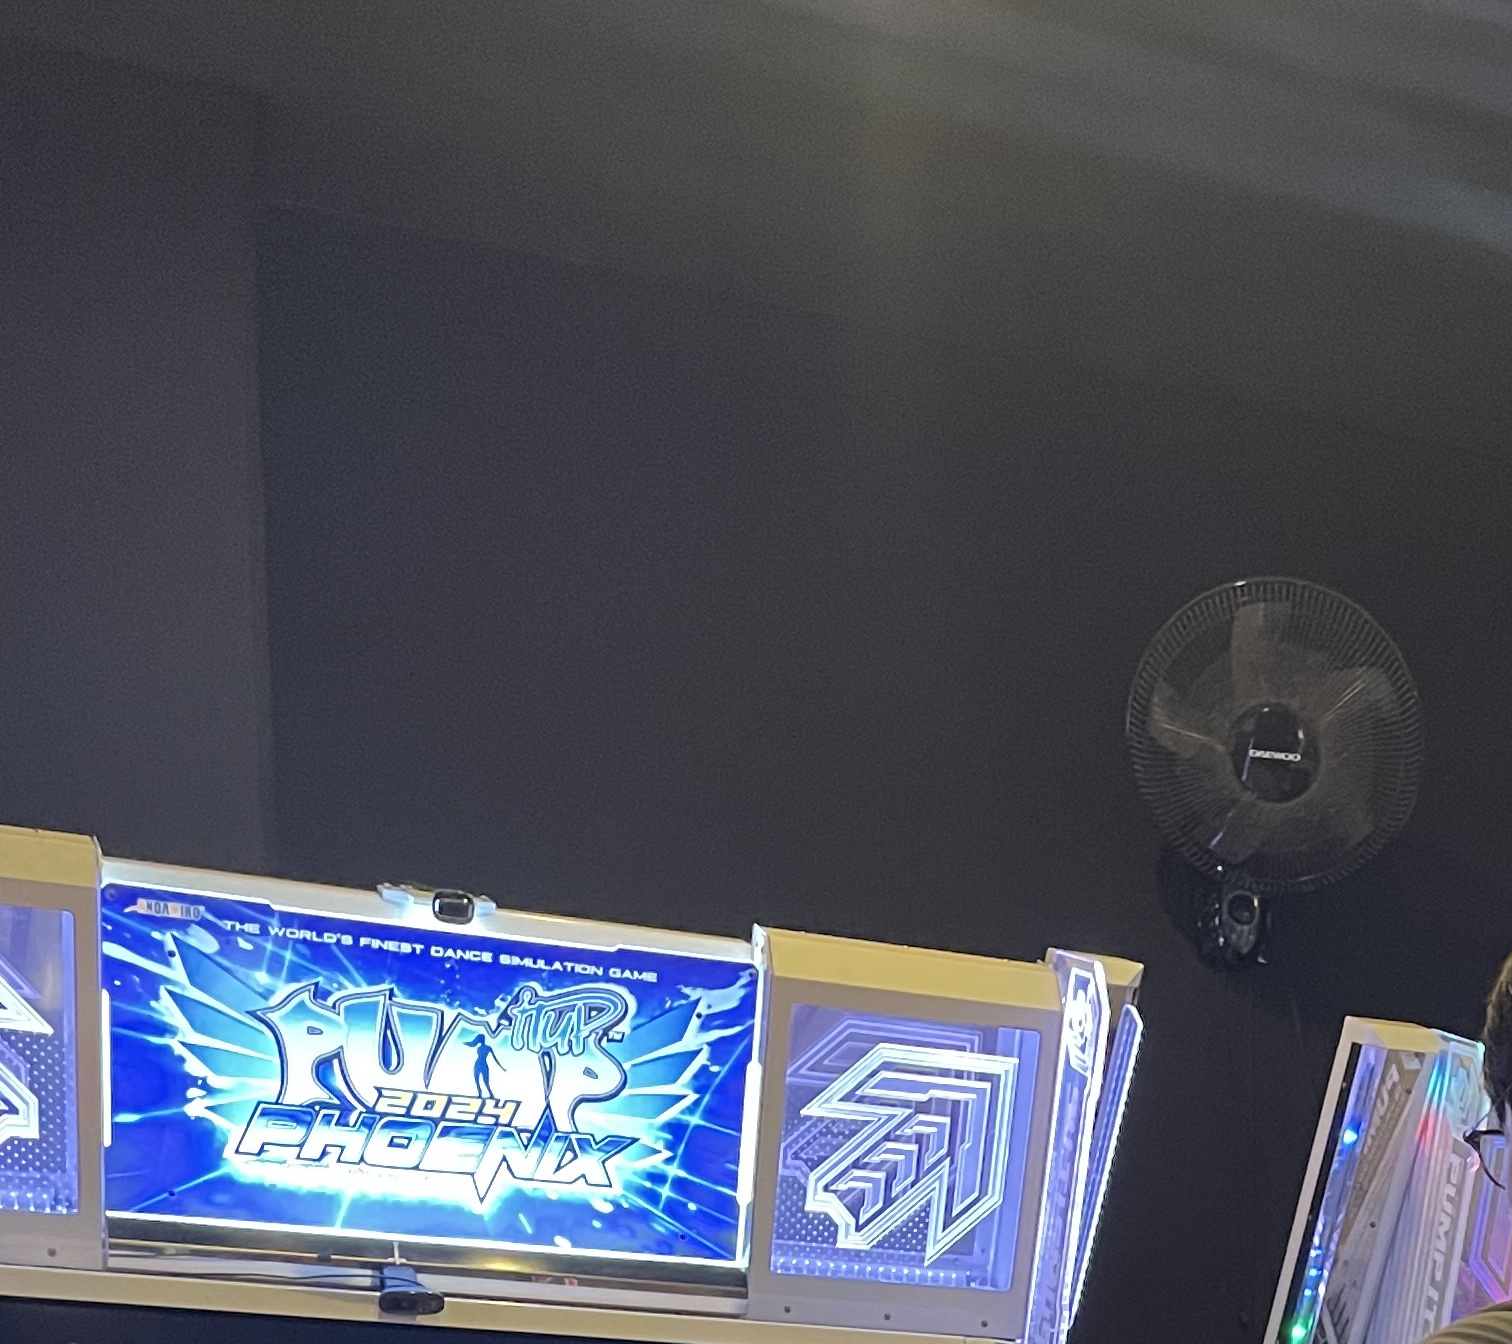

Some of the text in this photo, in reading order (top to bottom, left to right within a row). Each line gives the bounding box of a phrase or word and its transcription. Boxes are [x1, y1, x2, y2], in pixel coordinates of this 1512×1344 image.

[224, 920, 658, 984] THE WORLD'S FINEST DANCE SIMULATION GAME
[248, 982, 628, 1133] PUMP
[374, 1087, 521, 1126] 2024
[235, 1102, 640, 1203] PHOENIX
[1433, 1152, 1466, 1280] PUMP
